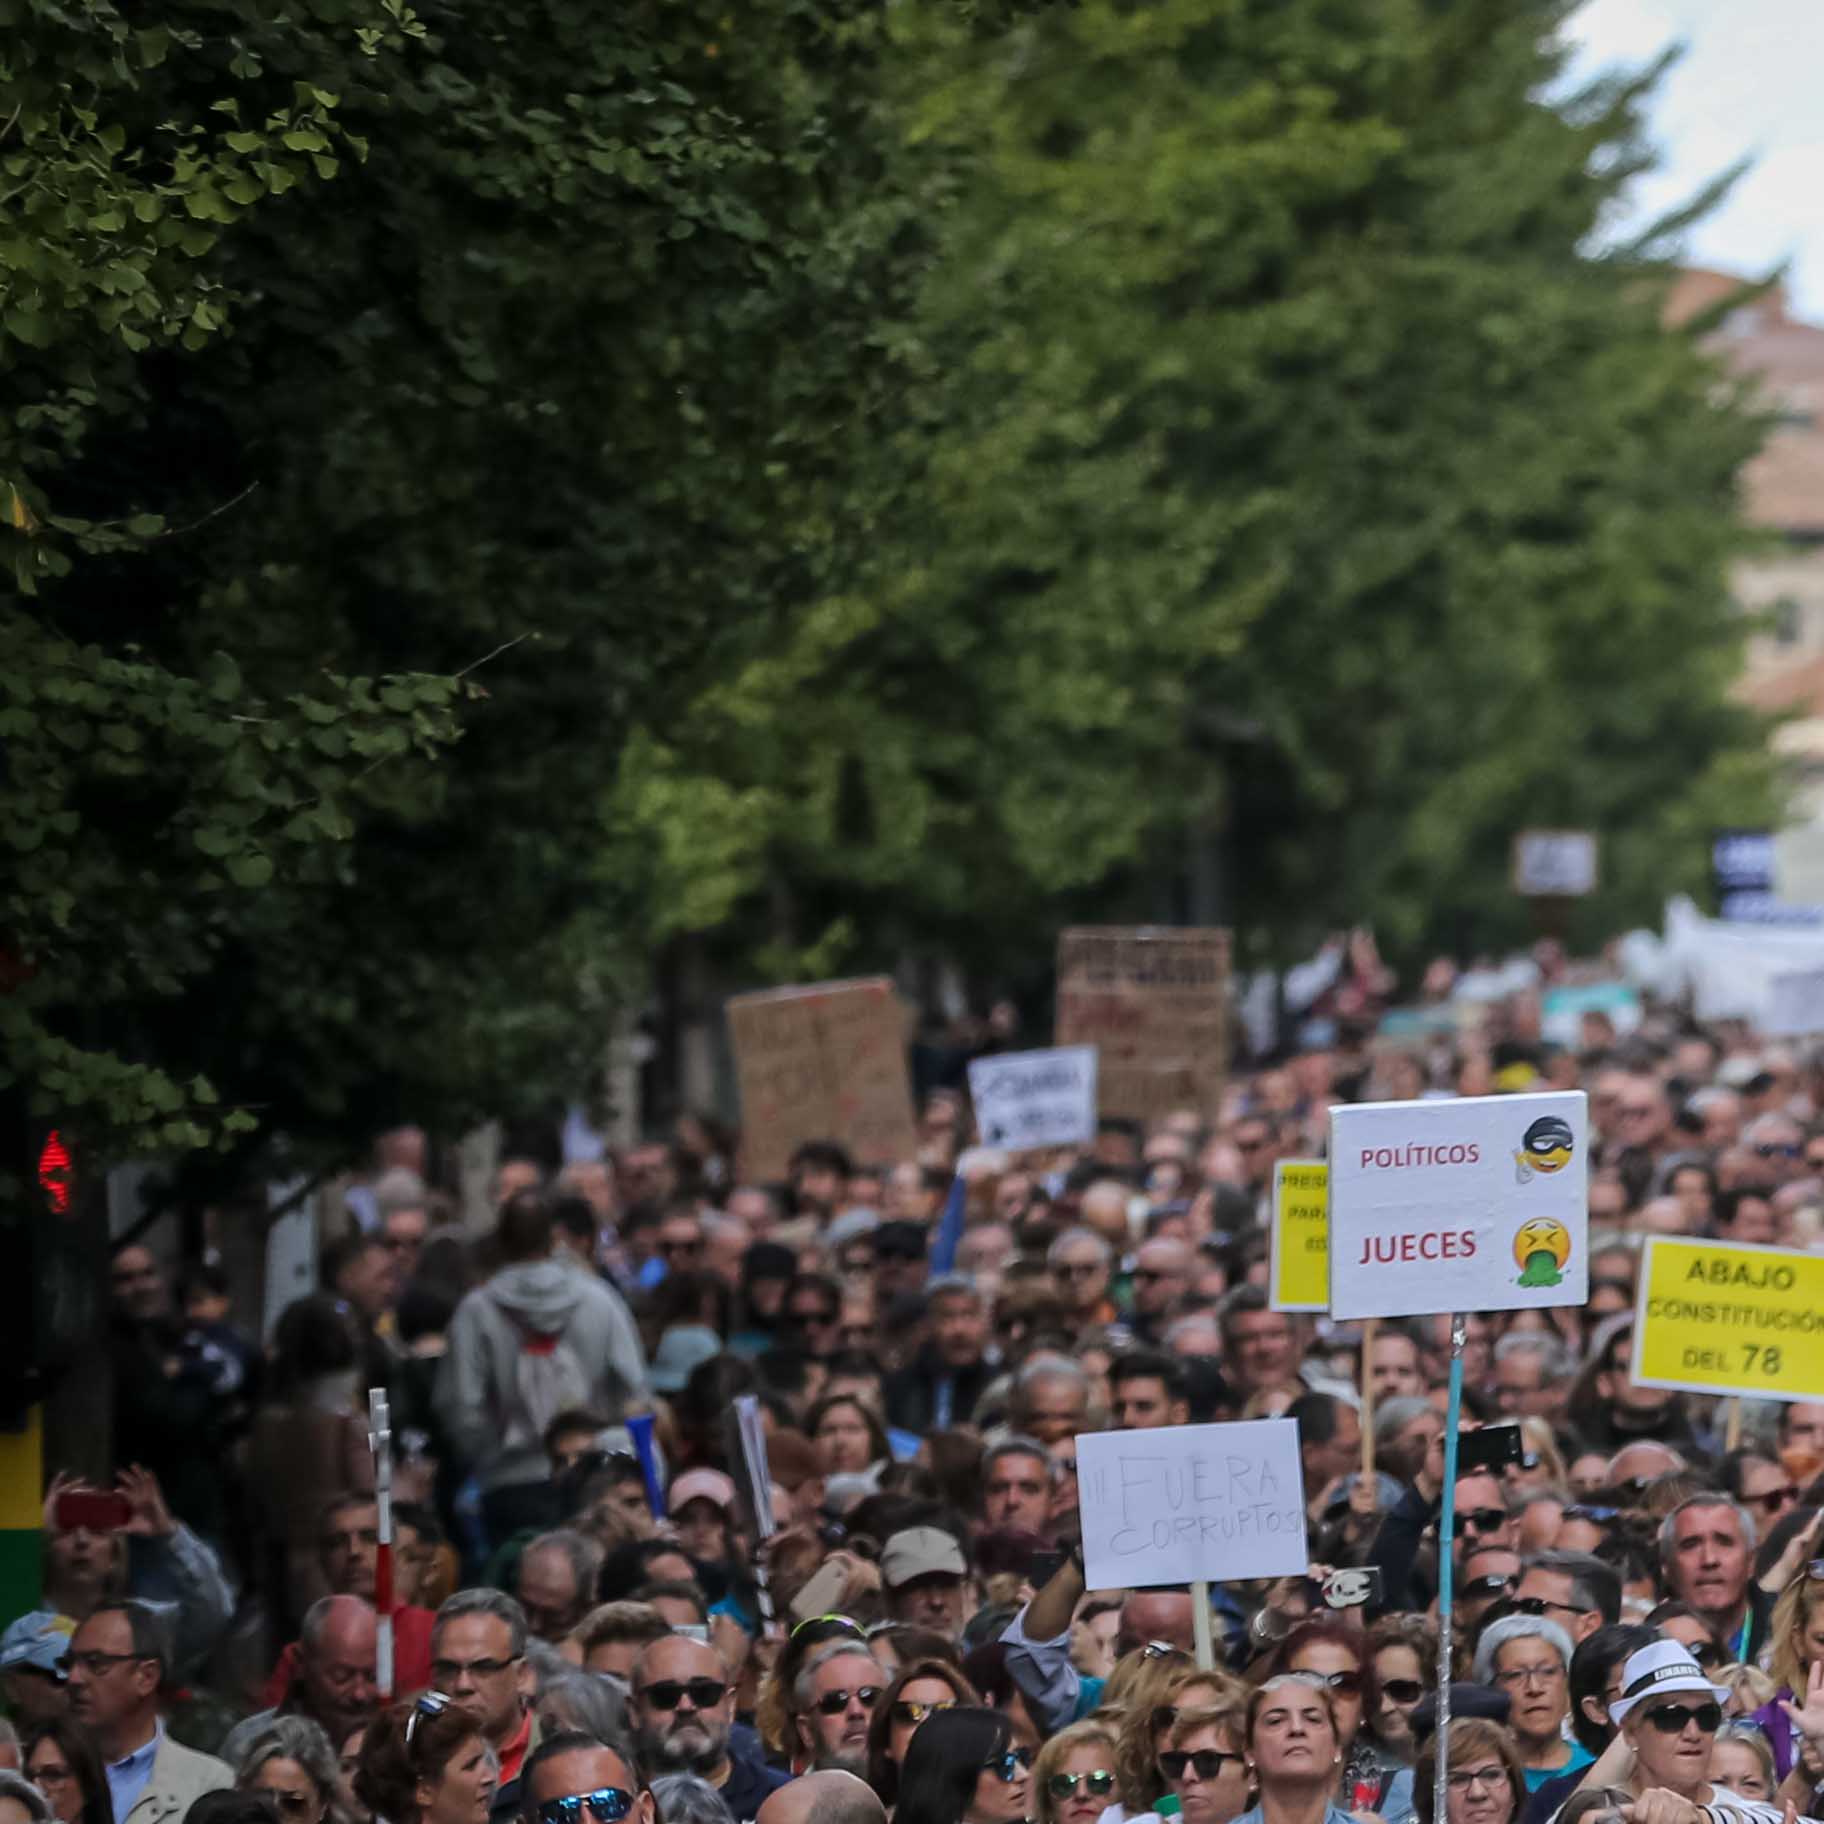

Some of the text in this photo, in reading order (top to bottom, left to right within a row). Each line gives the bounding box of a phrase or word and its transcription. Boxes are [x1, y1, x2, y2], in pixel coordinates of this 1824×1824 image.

[1360, 1142, 1480, 1169] POLÍTICOS
[1359, 1230, 1477, 1265] JUECES
[1684, 1257, 1796, 1291] ABAJO
[1682, 1343, 1782, 1376] DEL 78
